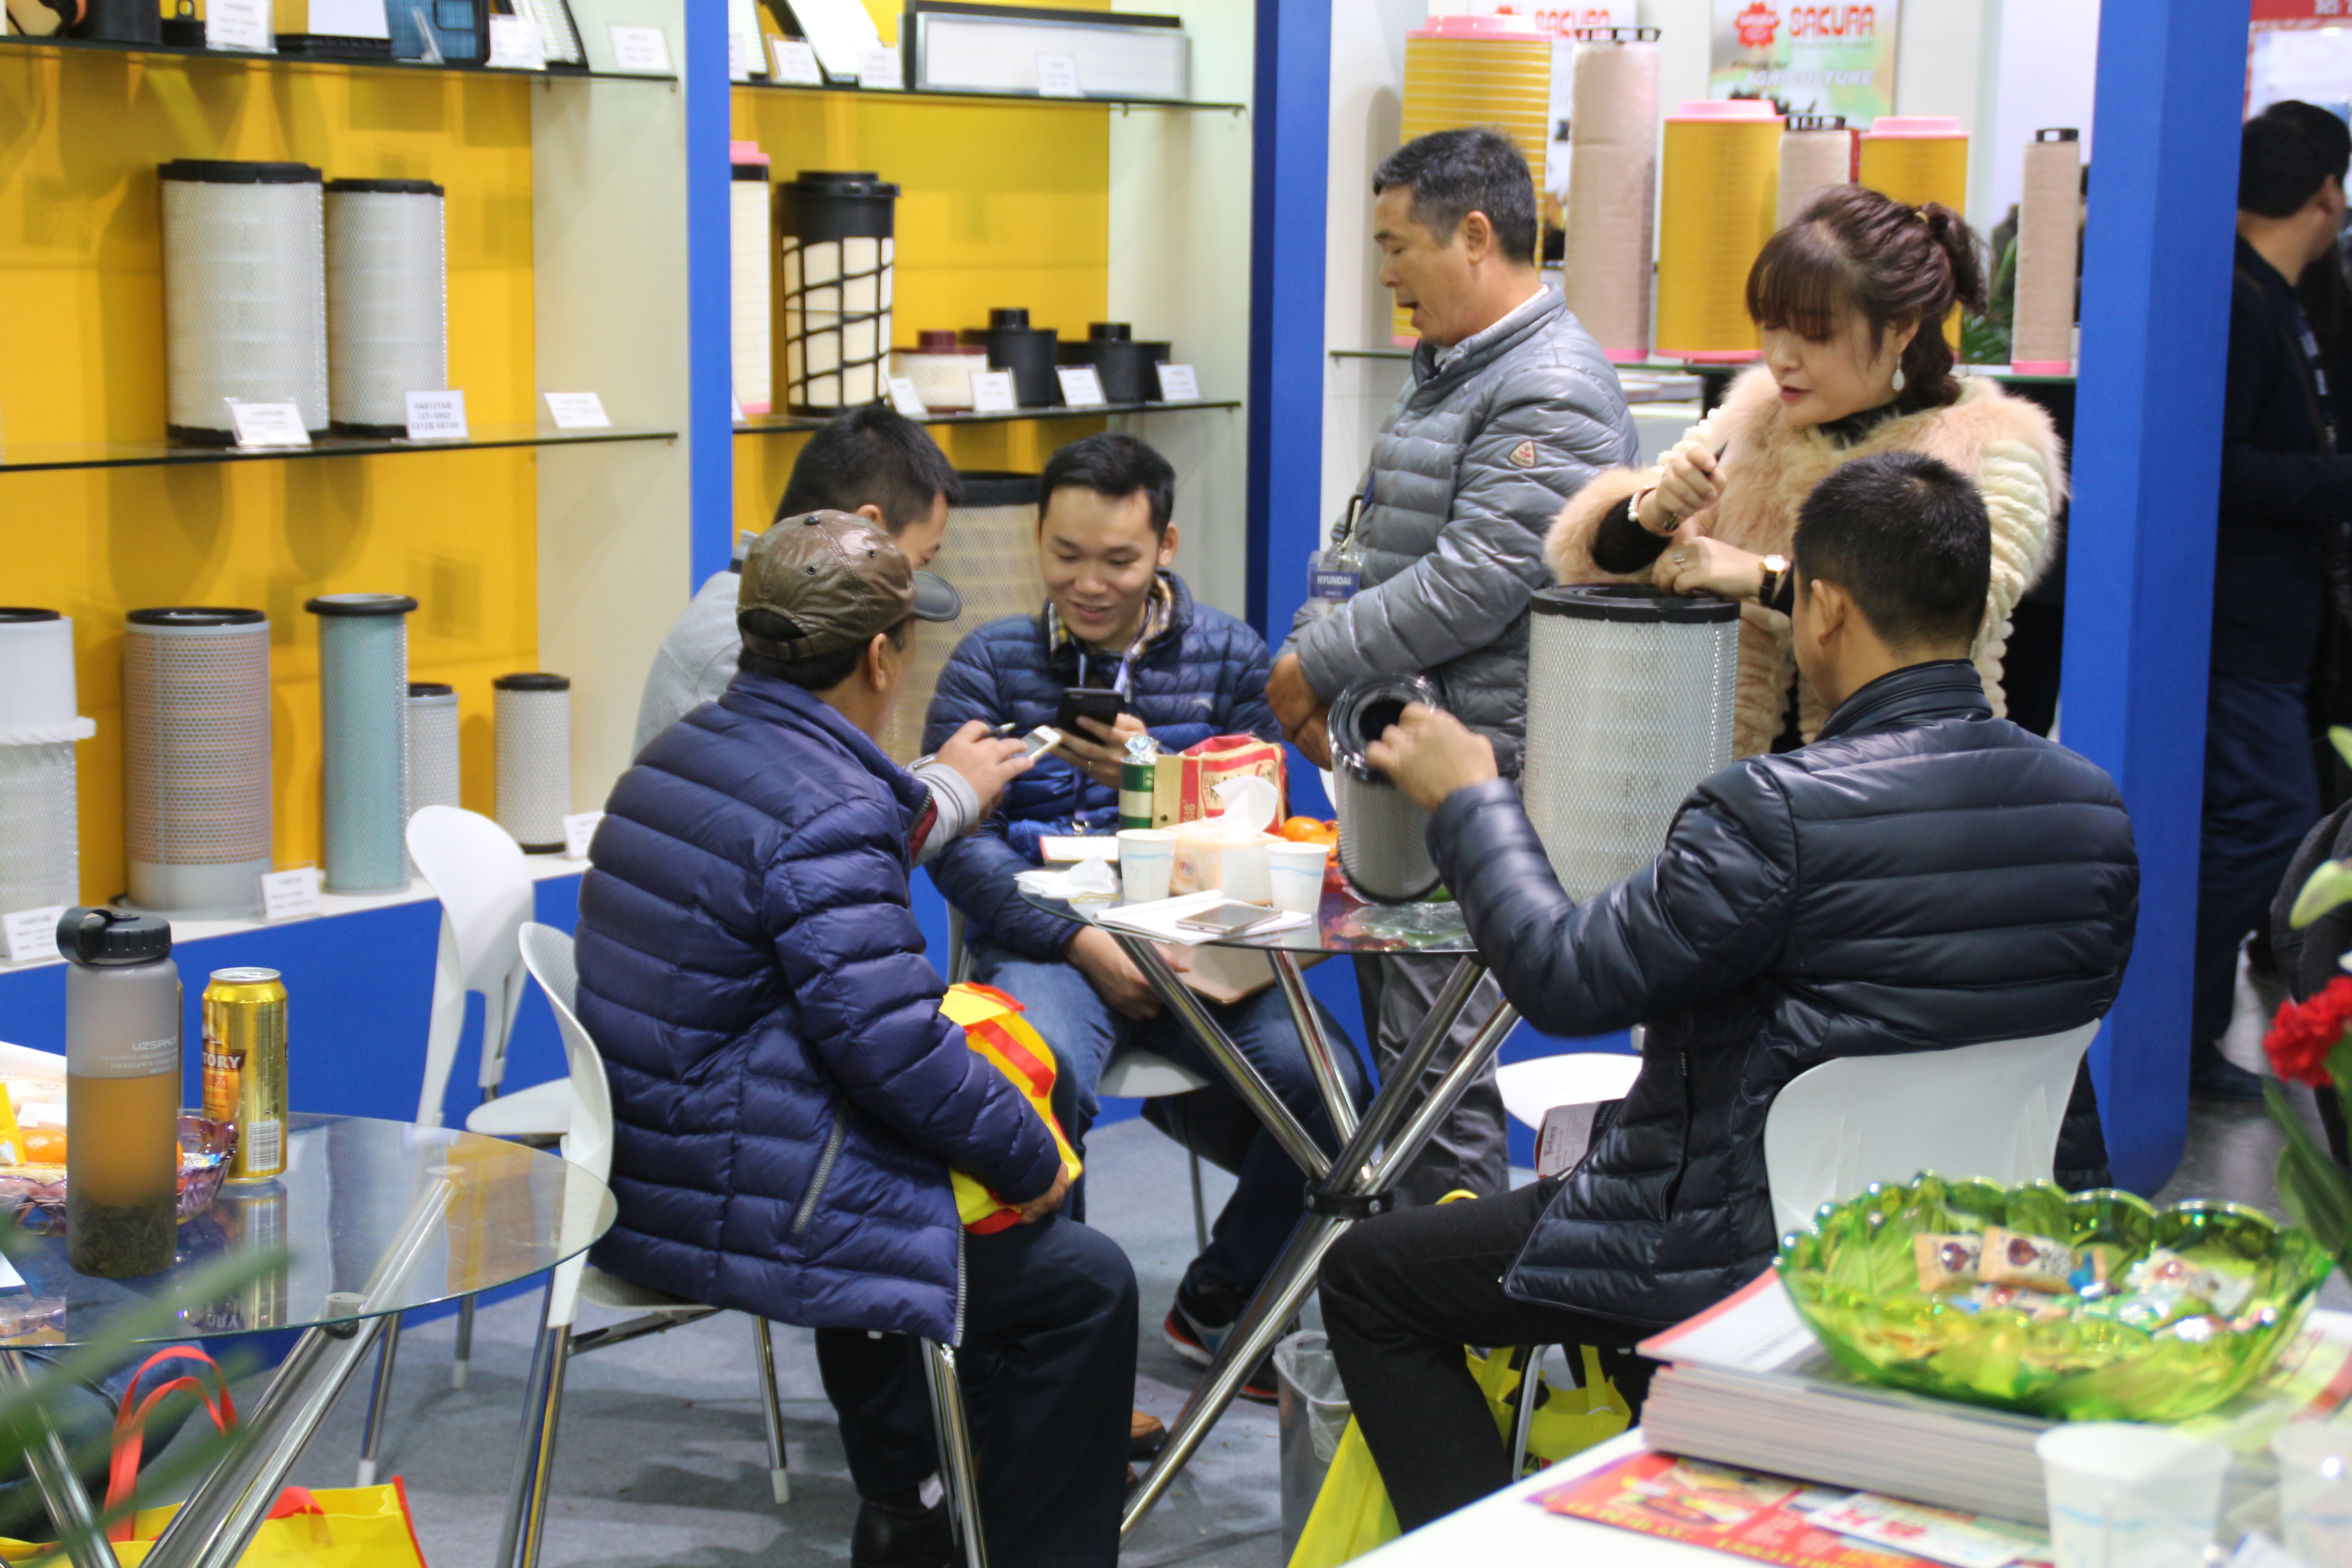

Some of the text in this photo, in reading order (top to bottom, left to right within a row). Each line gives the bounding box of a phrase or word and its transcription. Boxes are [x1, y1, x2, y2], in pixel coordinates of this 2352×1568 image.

[1790, 5, 1875, 36] SAKURA
[1743, 70, 1876, 86] AGRICULTURE
[1317, 575, 1351, 586] HYUNDAI
